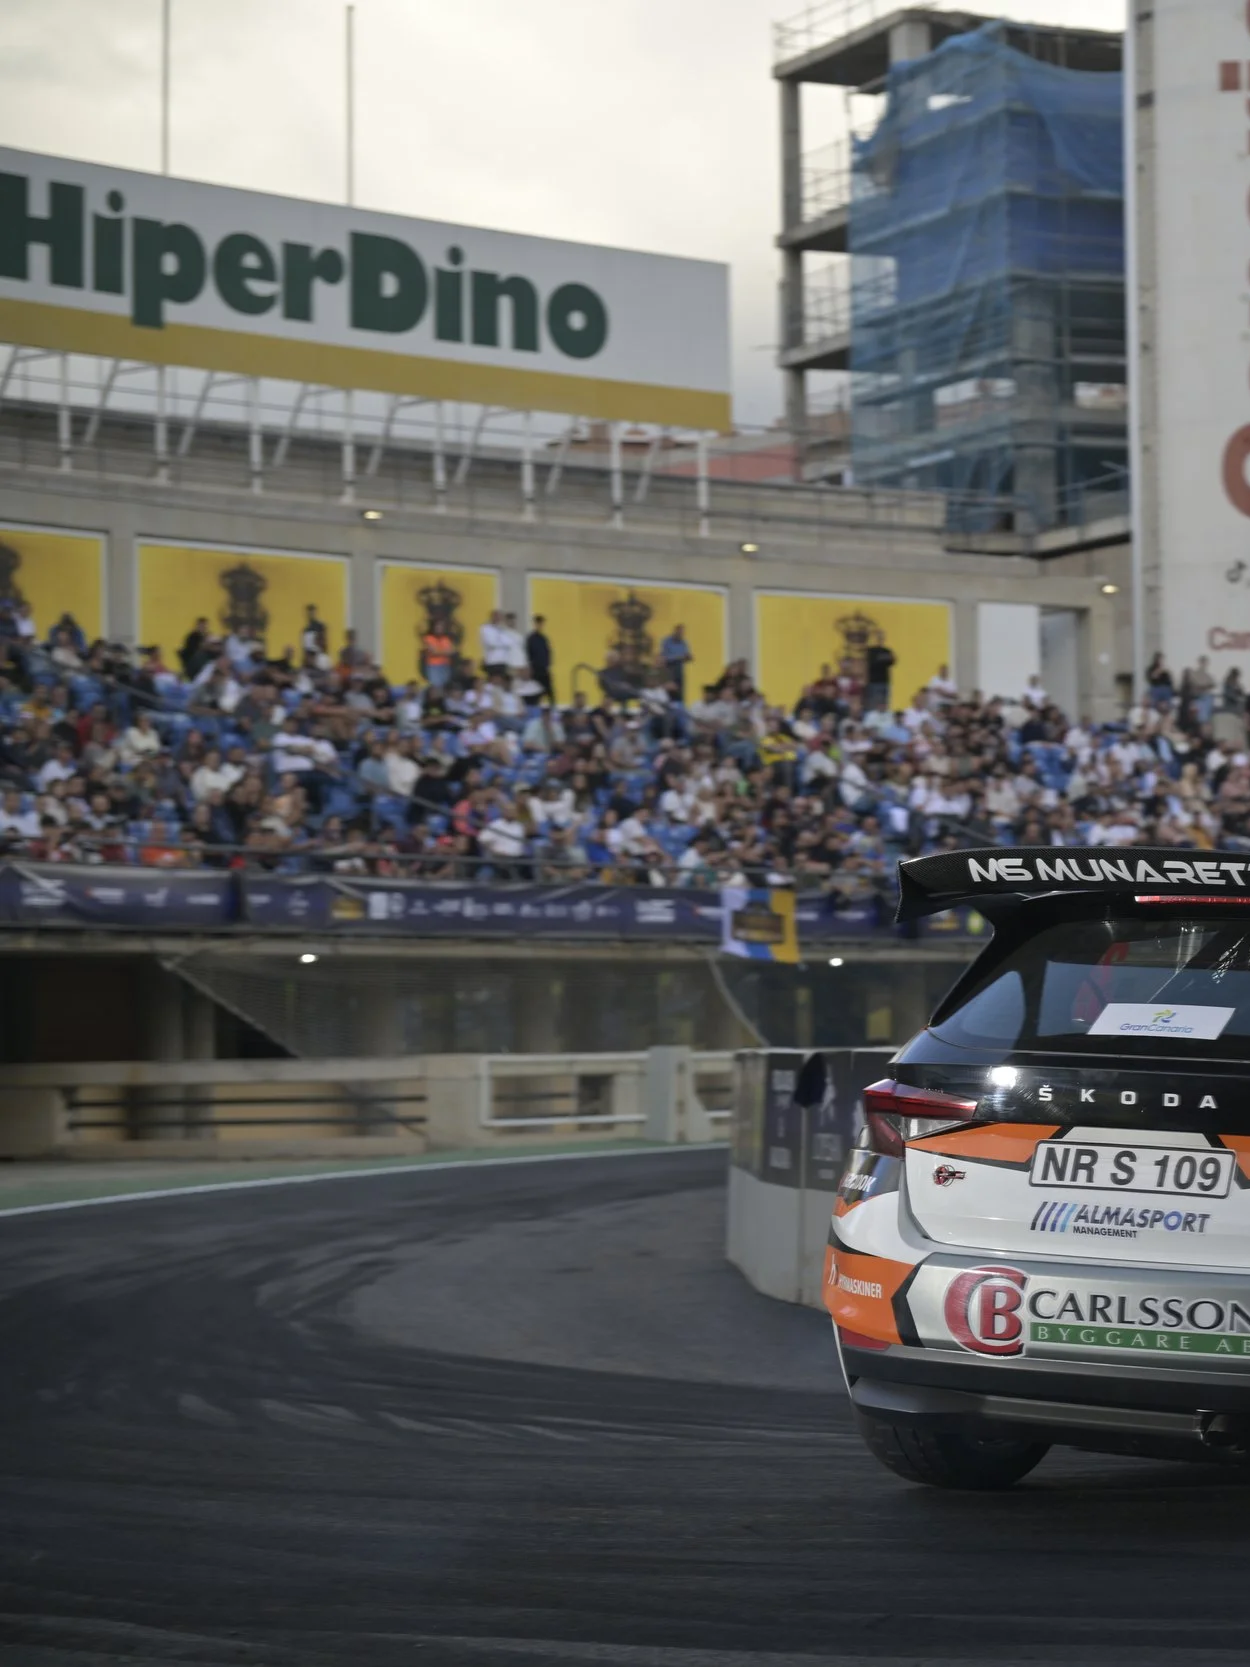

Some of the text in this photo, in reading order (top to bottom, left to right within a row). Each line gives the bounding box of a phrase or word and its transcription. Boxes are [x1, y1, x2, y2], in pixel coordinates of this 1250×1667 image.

[0, 171, 609, 360] HiperDino
[968, 858, 1033, 882] MS
[1038, 1086, 1218, 1109] ŠKODA
[1041, 1147, 1221, 1192] NR S 109
[1073, 1203, 1211, 1233] ALMASPORT
[1073, 1226, 1138, 1239] MANAGEMENT
[1037, 1326, 1193, 1351] BYGGARE
